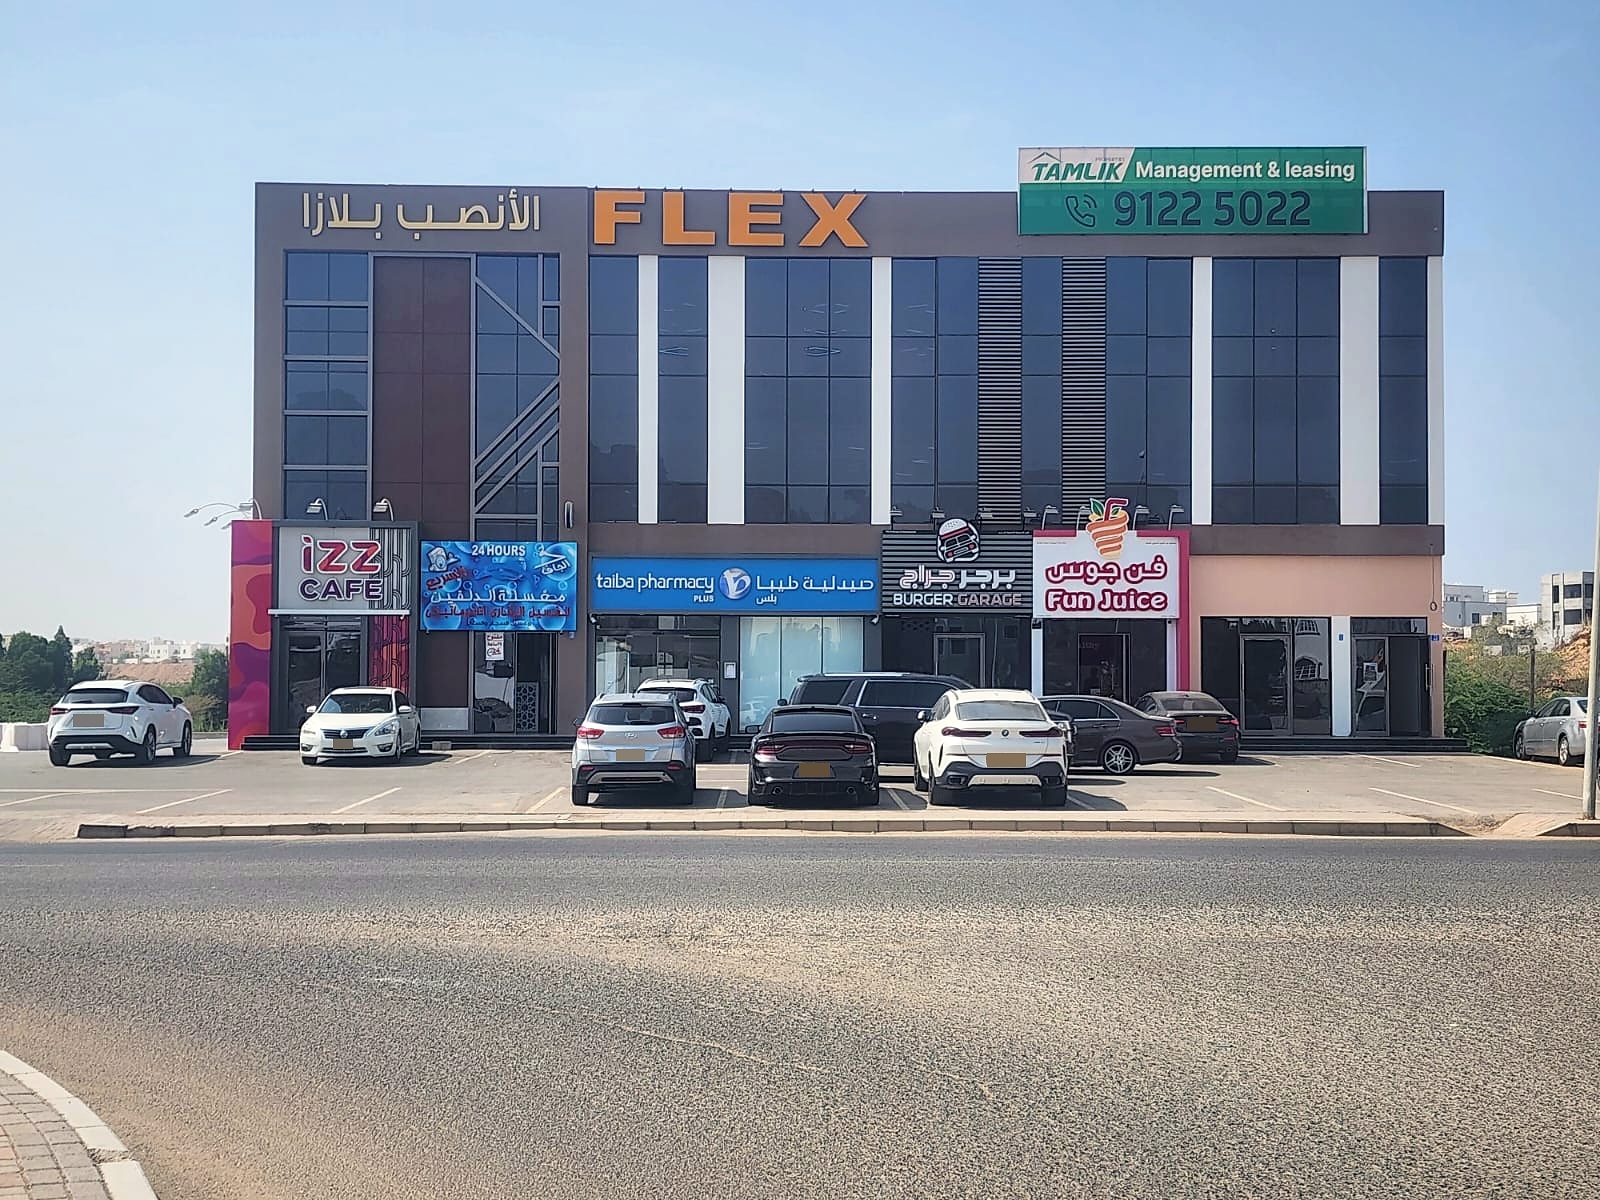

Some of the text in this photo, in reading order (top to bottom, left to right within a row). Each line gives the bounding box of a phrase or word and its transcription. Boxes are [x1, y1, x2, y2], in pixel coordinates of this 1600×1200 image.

[1031, 162, 1123, 181] TAMLIK
[1135, 160, 1355, 182] Management & leasing
[303, 188, 541, 240] الأنصب بلازا
[593, 190, 869, 247] FLEX
[1113, 190, 1312, 226] 9122 5022
[471, 545, 526, 556] 24 HOURS
[899, 564, 1016, 590] برجر جراج
[1124, 553, 1167, 583] فن
[299, 579, 384, 601] CAFE
[596, 573, 715, 593] taiba pharmacy
[756, 574, 874, 592] صيدلية طيبا
[693, 595, 714, 603] PLUS
[756, 594, 777, 604] بلس
[893, 593, 1022, 606] BURGER GARAGE
[1046, 590, 1168, 611] Fun Juice
